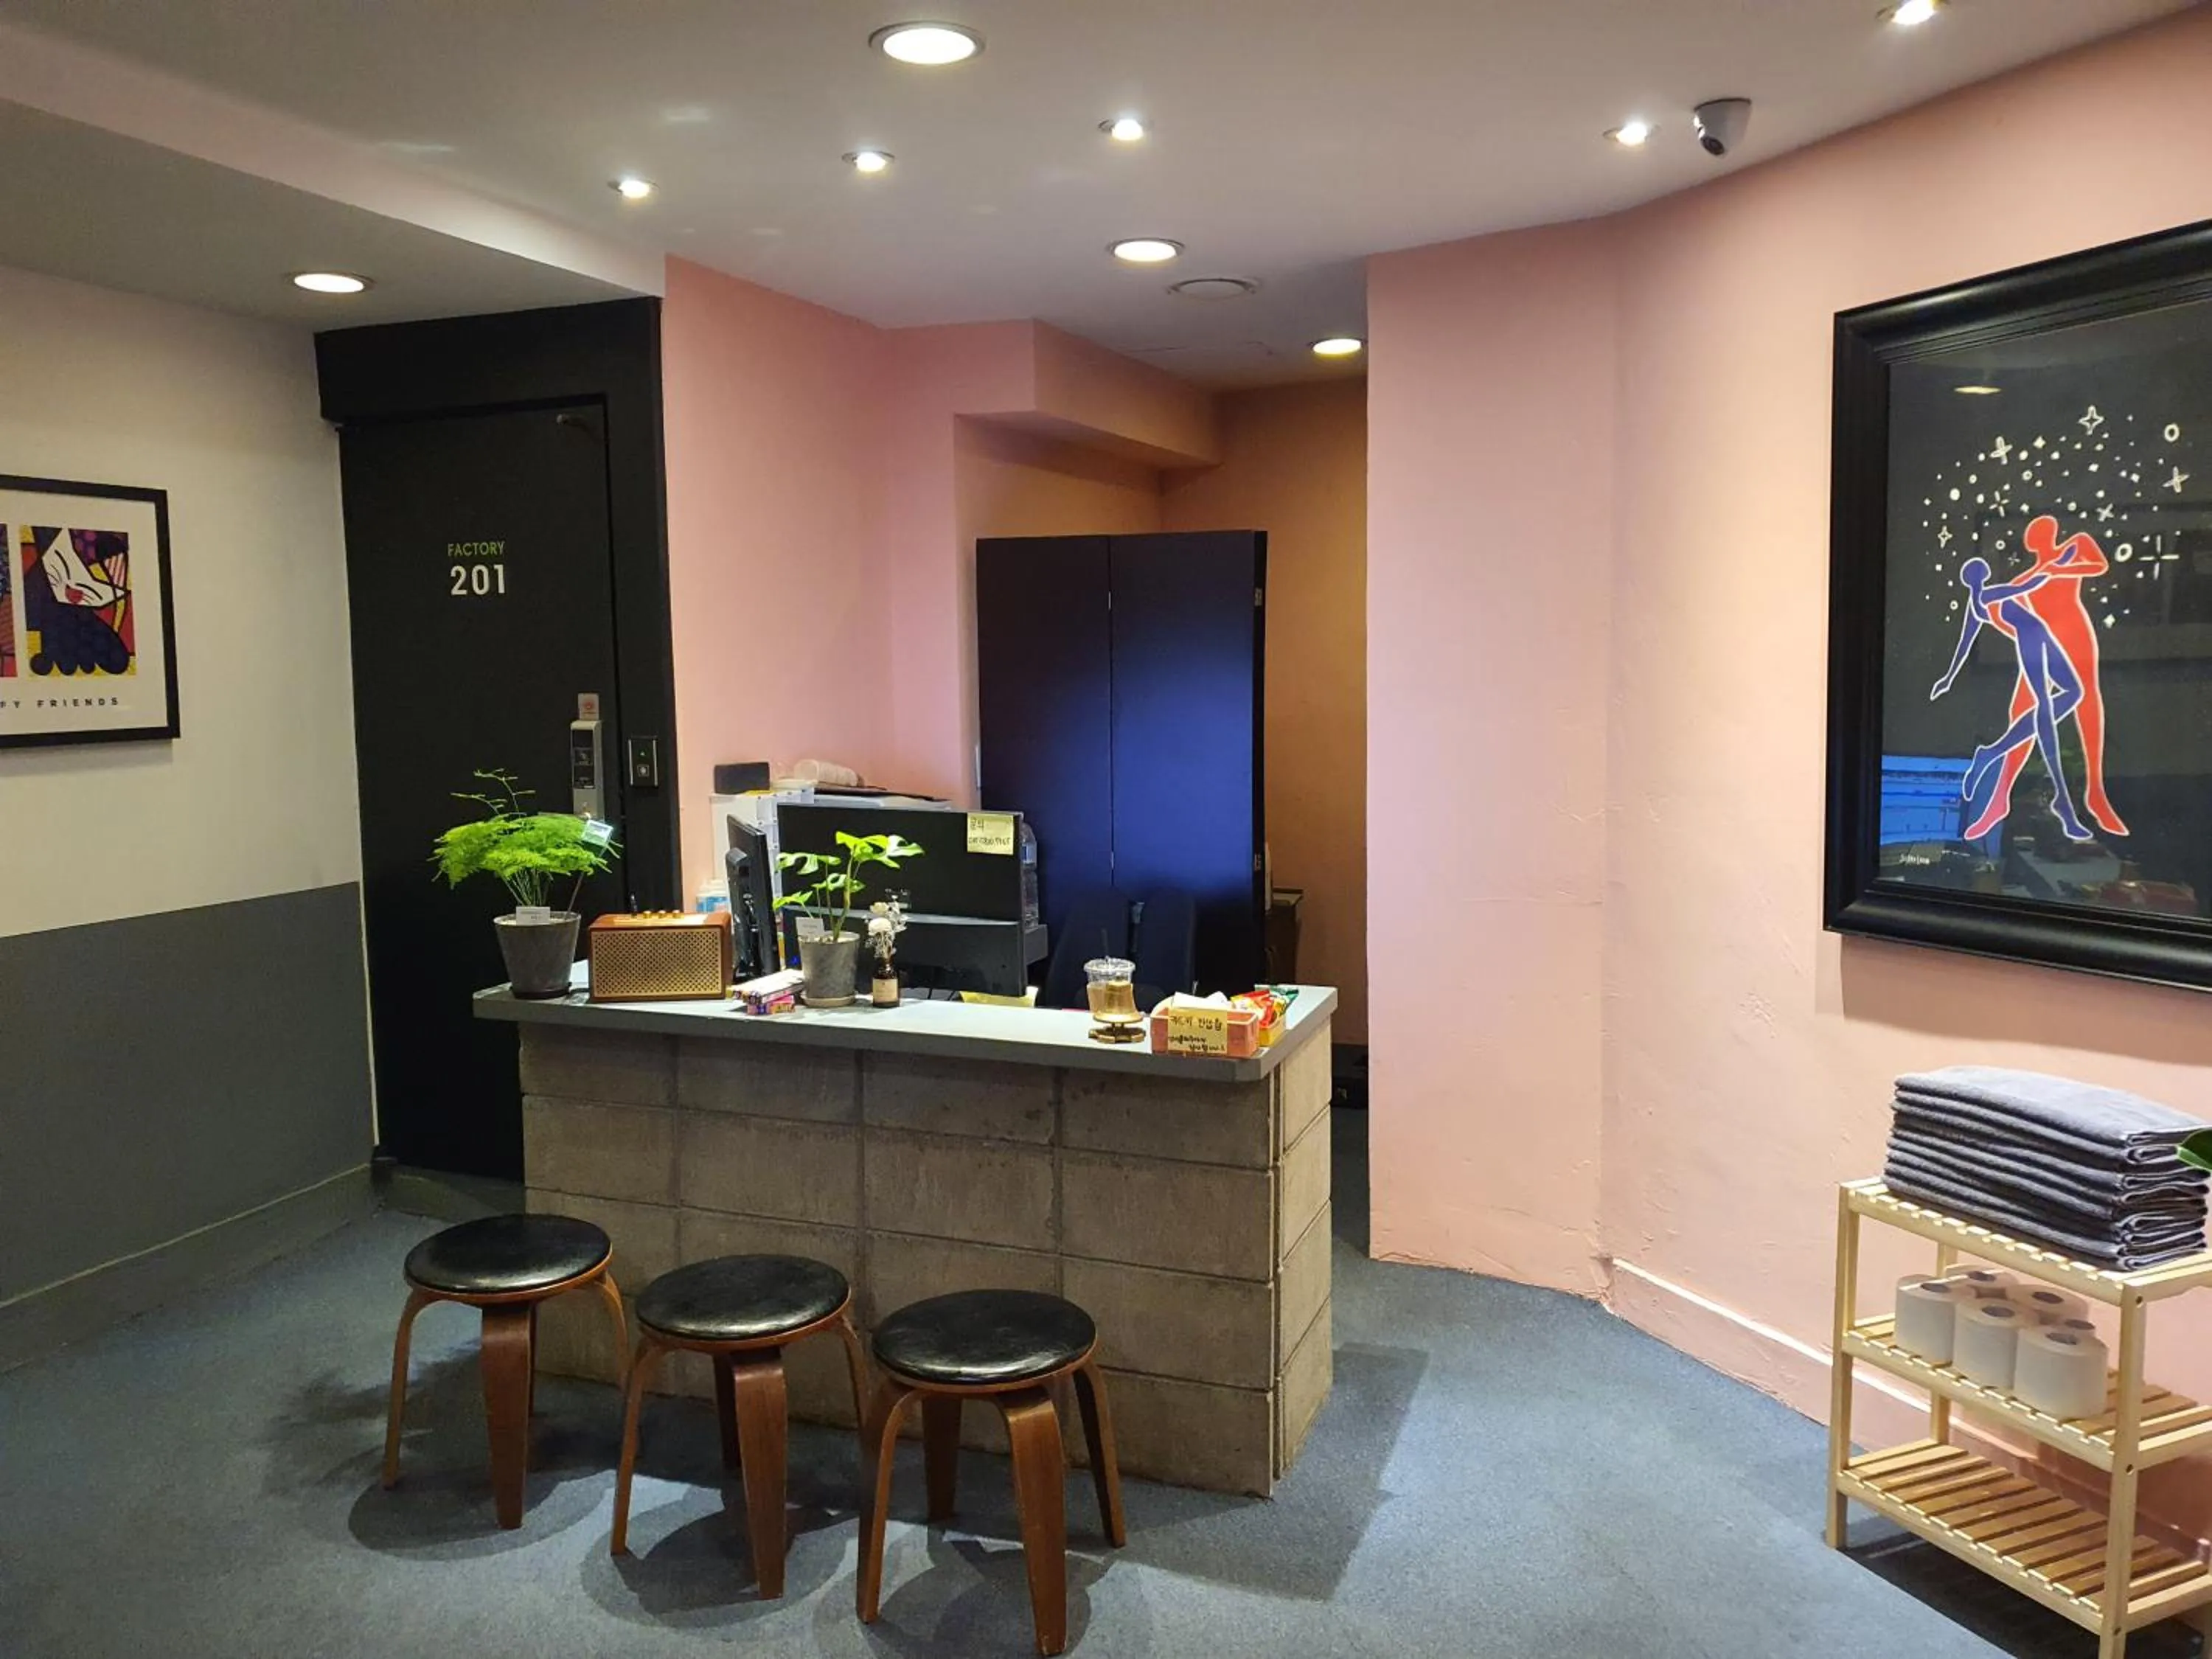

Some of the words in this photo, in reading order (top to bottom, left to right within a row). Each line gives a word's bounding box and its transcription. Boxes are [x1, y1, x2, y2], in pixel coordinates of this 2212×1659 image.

[448, 540, 505, 557] FACTORY
[451, 564, 506, 596] 201
[37, 698, 119, 708] FRIENDS
